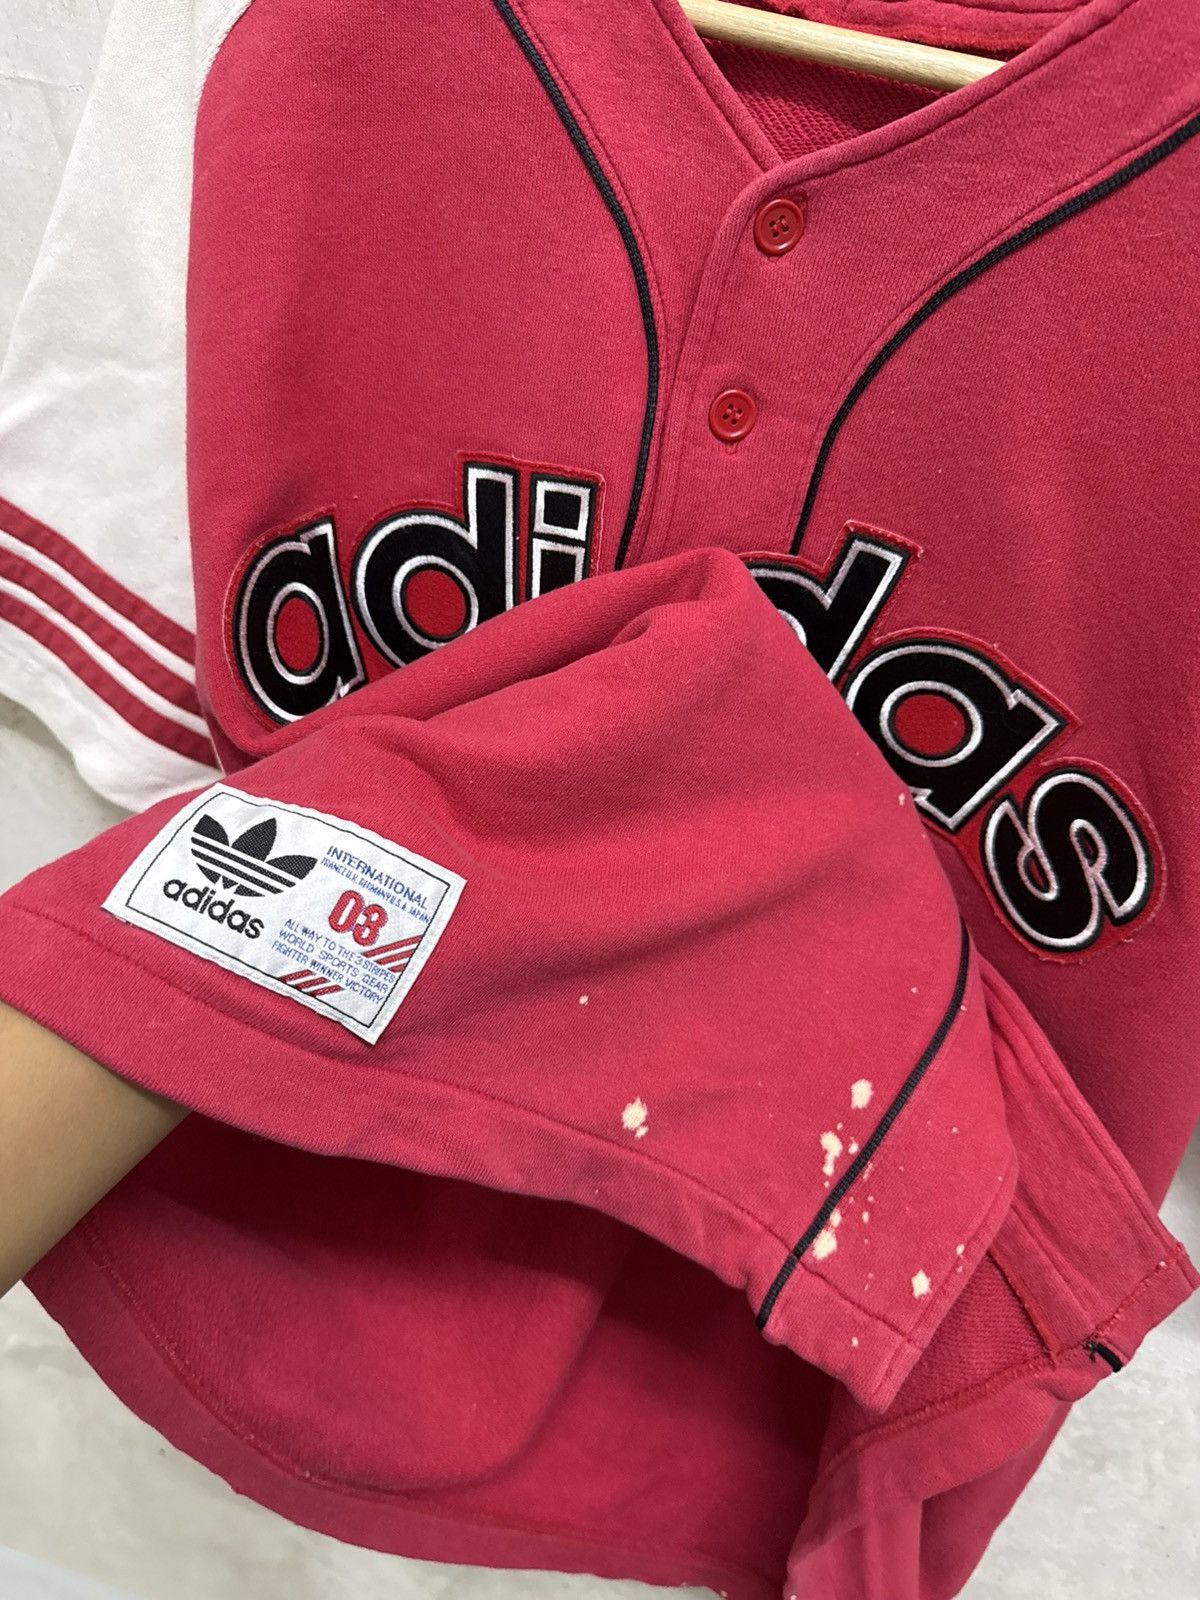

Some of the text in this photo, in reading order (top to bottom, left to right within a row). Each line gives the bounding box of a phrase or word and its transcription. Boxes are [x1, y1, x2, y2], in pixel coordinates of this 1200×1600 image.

[162, 878, 265, 939] adidas
[326, 846, 428, 910] INTERNATIONAL
[328, 890, 388, 946] 03
[271, 940, 384, 1004] FIGHTER WINNER VICTORY
[279, 929, 389, 994] WORLD SPORTS GEAR
[284, 918, 396, 983] ALL WAY TO THE 3 STRIPES
